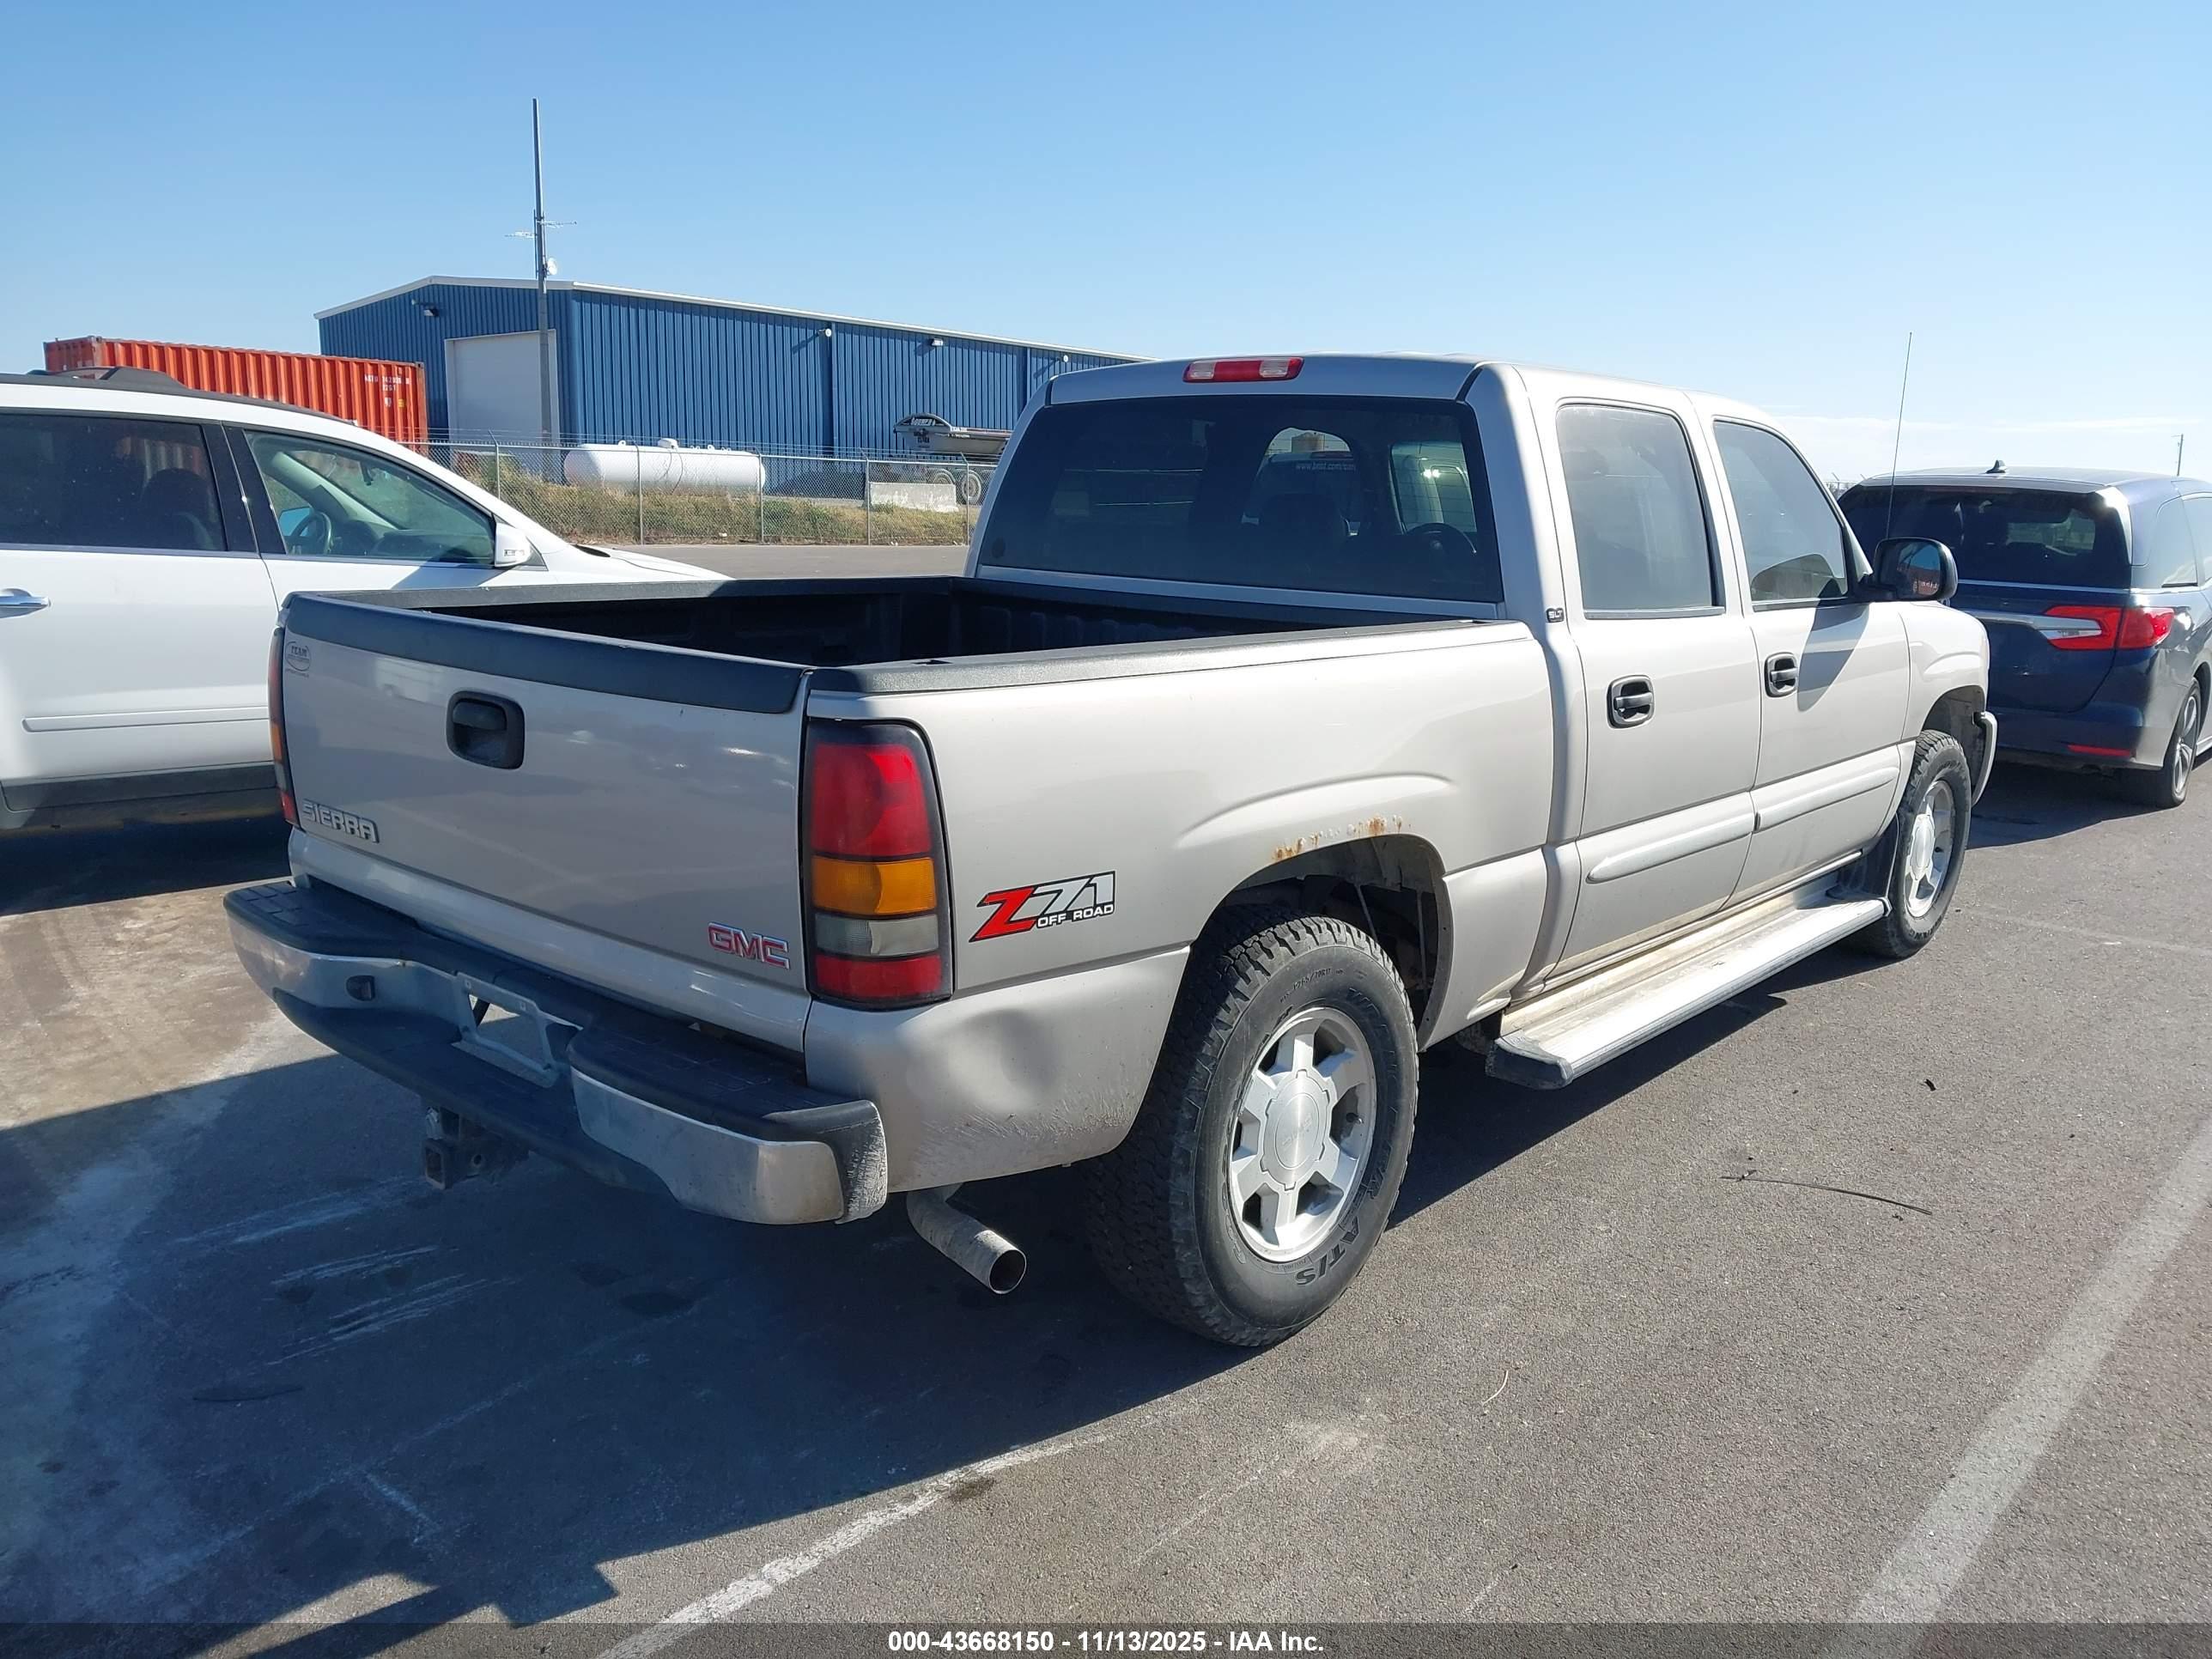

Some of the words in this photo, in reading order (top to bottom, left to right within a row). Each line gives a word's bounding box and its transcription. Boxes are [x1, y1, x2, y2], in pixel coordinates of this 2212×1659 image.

[302, 799, 380, 843] SIERRA
[969, 871, 1116, 943] Z71
[1036, 912, 1067, 928] OFF
[1073, 903, 1115, 921] ROAD
[708, 921, 791, 969] GMC
